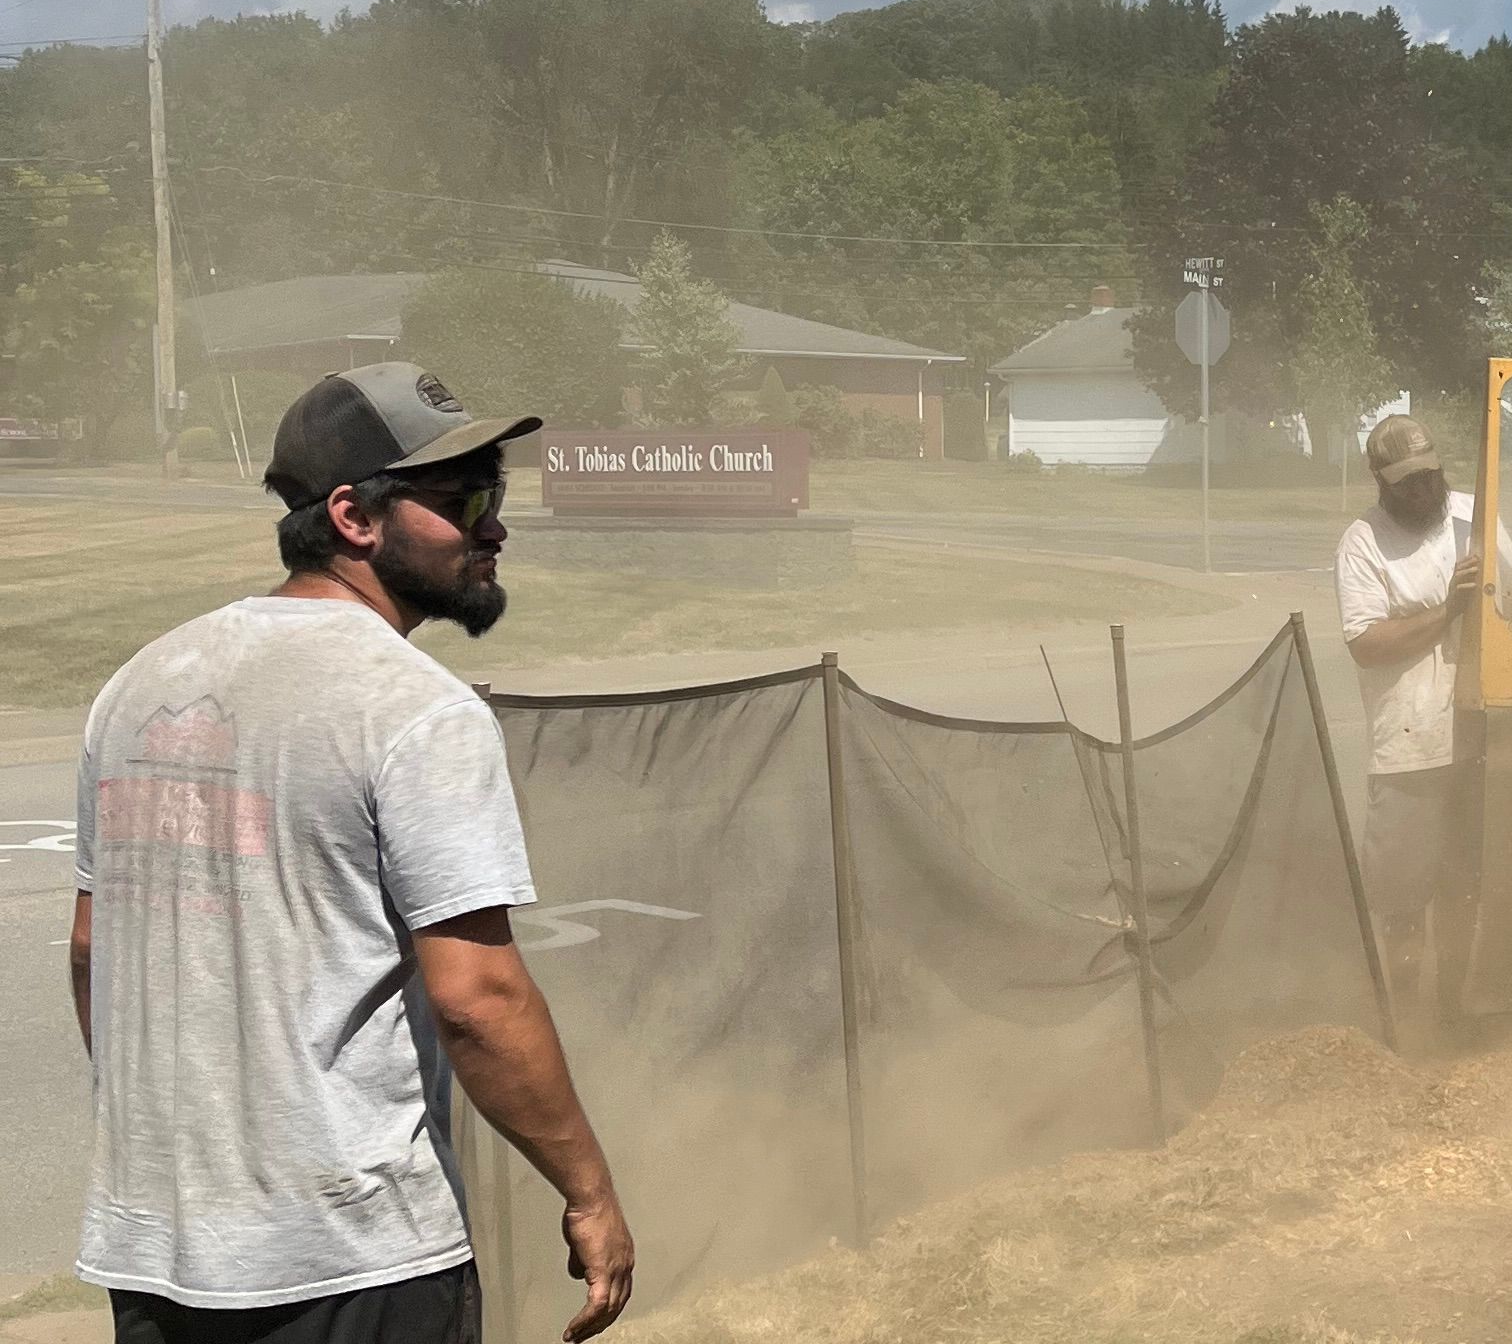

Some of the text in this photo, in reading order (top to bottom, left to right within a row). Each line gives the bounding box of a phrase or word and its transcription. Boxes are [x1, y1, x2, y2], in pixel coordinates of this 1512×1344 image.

[1185, 257, 1225, 269] HEWITT ST
[1184, 270, 1223, 286] MAIN ST
[548, 444, 774, 472] St. Tobias Catholic Church
